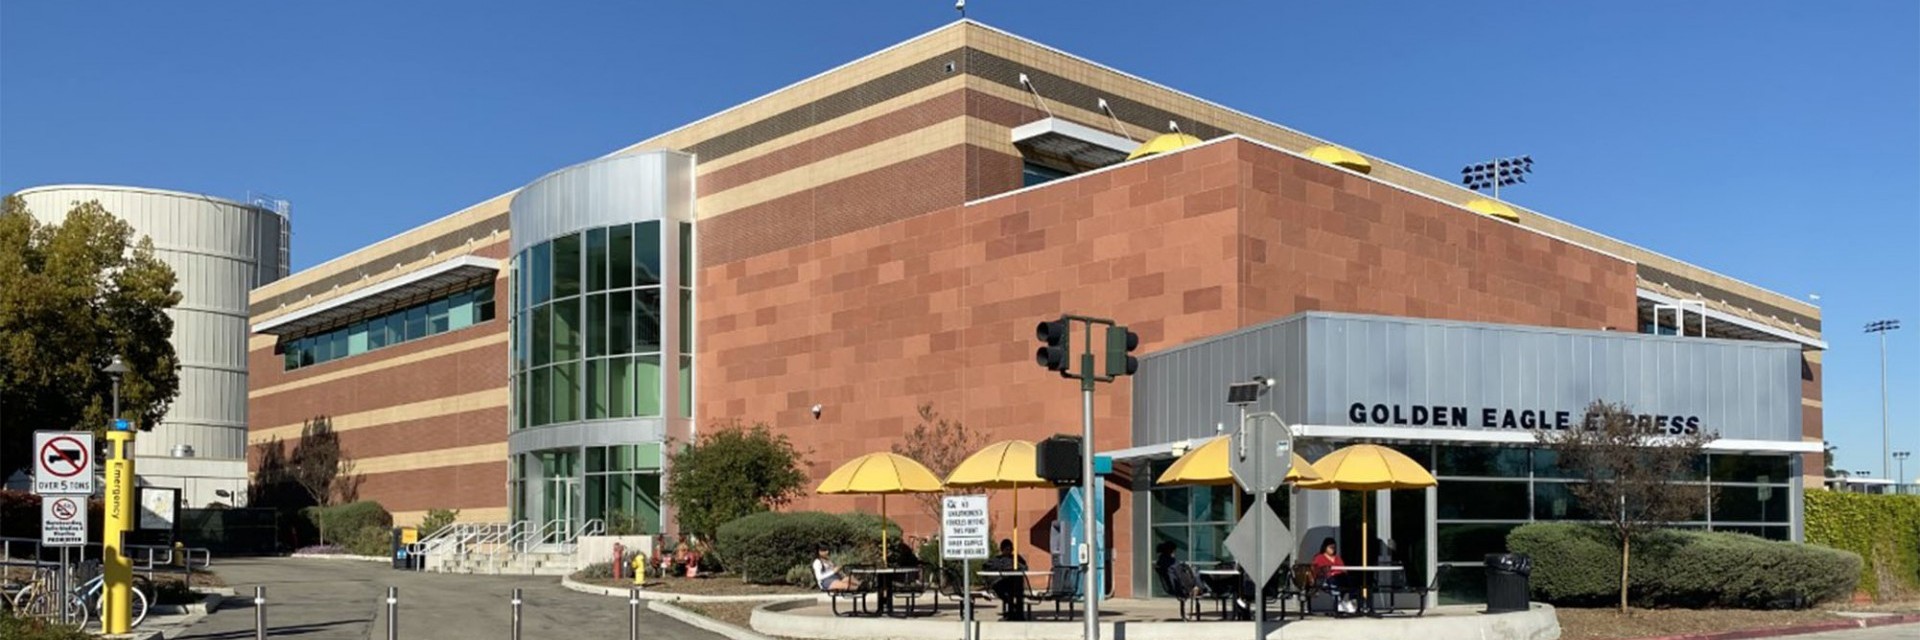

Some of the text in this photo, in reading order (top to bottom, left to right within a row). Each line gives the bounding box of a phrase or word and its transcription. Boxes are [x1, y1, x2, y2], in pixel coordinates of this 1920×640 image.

[1349, 402, 1468, 428] GOLDEN
[1482, 408, 1570, 431] EAGLE
[38, 480, 90, 490] OVER 5 TONS
[111, 462, 123, 520] Emergency
